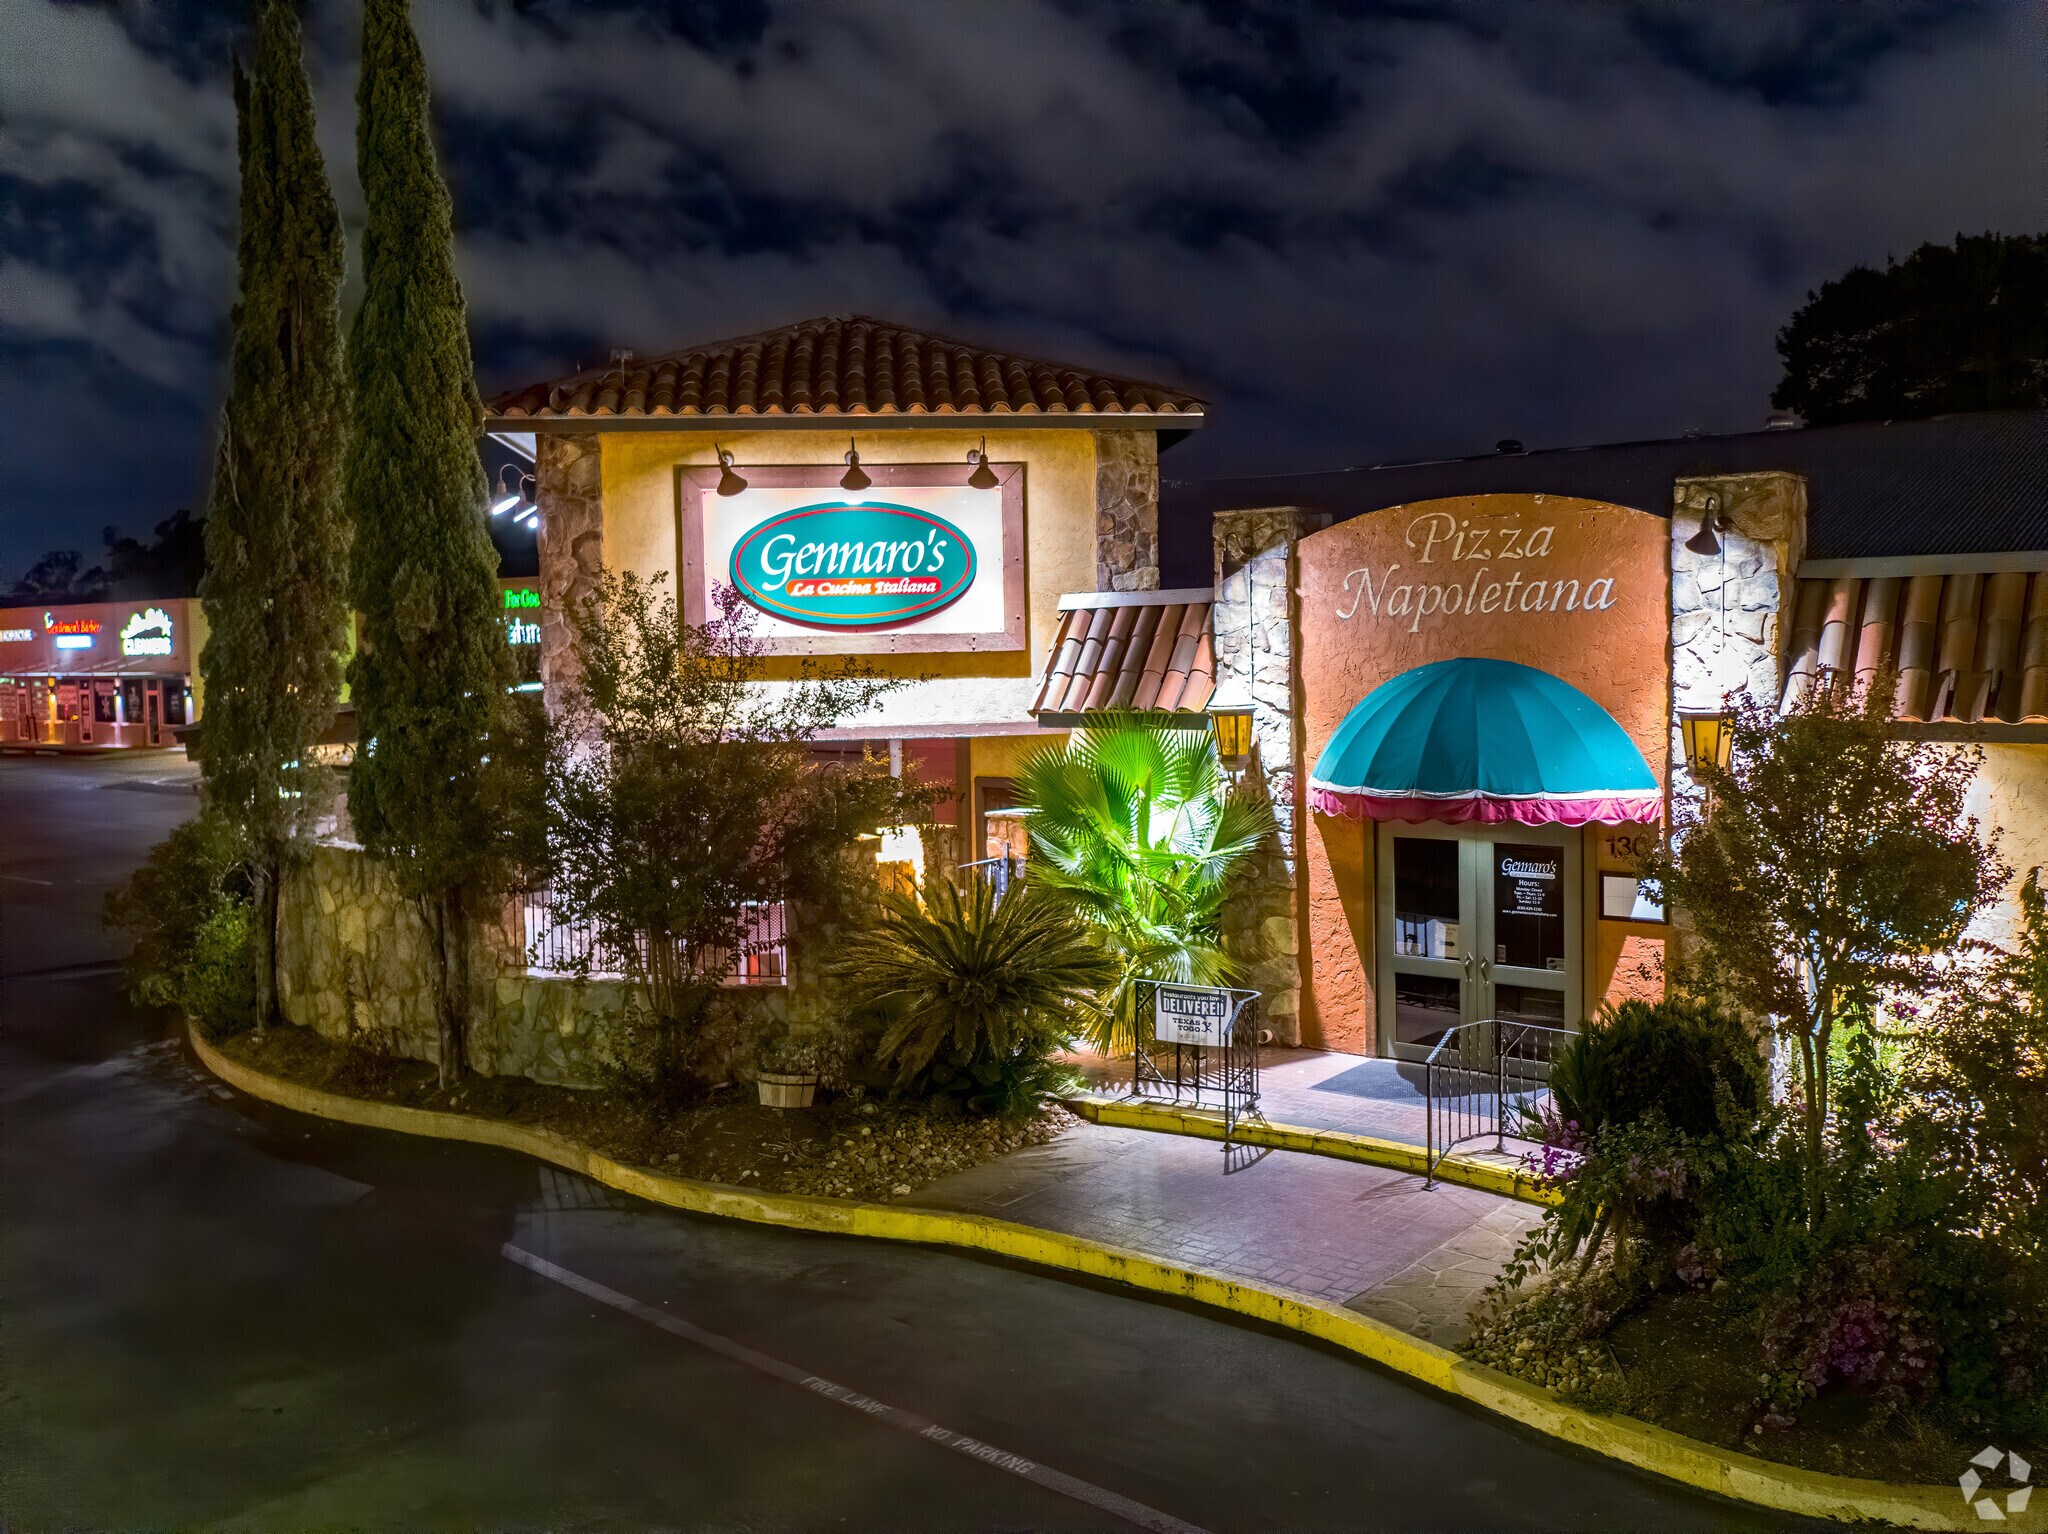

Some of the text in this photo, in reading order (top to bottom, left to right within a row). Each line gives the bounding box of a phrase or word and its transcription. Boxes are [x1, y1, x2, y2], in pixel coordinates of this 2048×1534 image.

[1406, 512, 1556, 564] Pizza
[761, 528, 947, 591] Gennaro's
[790, 578, 937, 597] La Cucina Italiana
[1336, 564, 1618, 633] Napoletana
[1501, 858, 1557, 876] Gennaro's
[1163, 997, 1224, 1016] DELIVERED
[1172, 1017, 1201, 1026] TEXAS
[1178, 1025, 1201, 1033] TOGO
[800, 1376, 893, 1416] FIRE LANE
[920, 1424, 1037, 1475] NO PARKING
